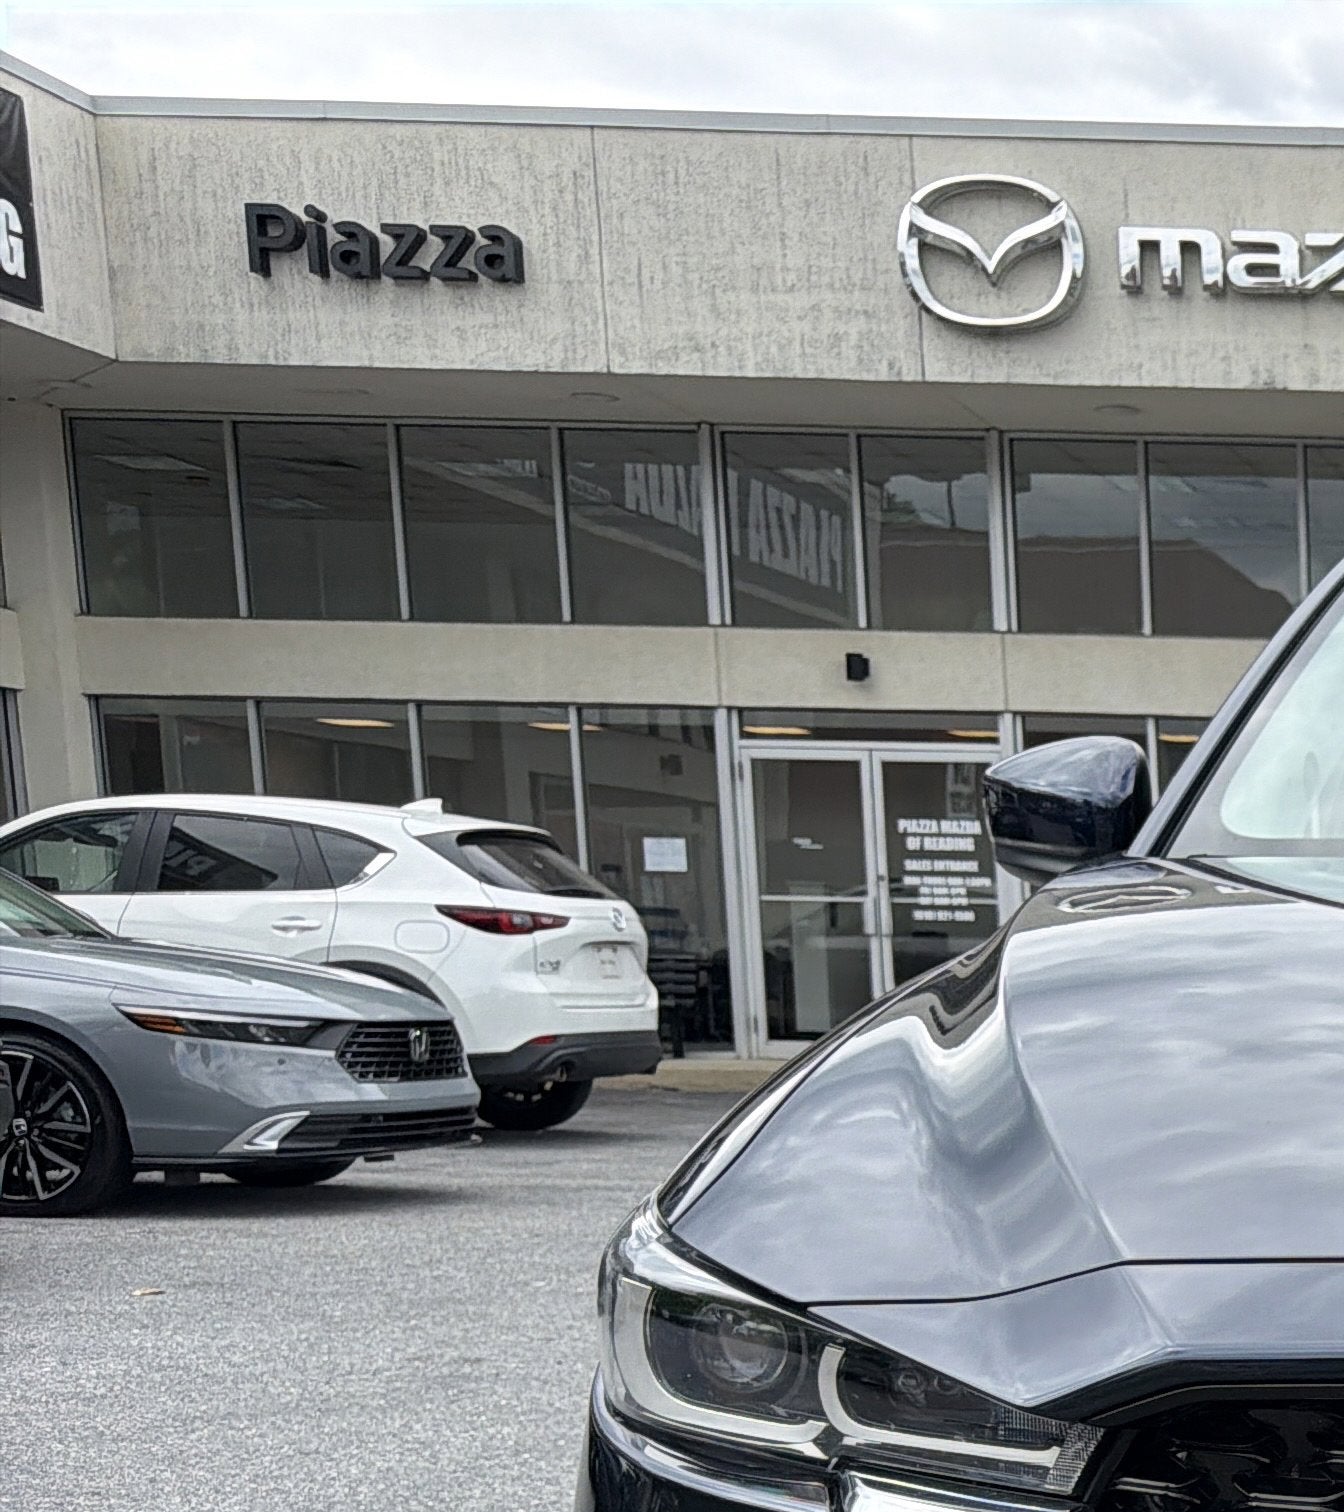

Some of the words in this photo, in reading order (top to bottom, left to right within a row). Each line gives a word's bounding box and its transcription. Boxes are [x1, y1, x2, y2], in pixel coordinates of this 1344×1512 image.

[244, 202, 526, 284] Piazza
[897, 818, 939, 834] PIAZZA
[940, 819, 983, 835] MAZDA
[905, 836, 921, 851] OF
[923, 836, 976, 852] READING
